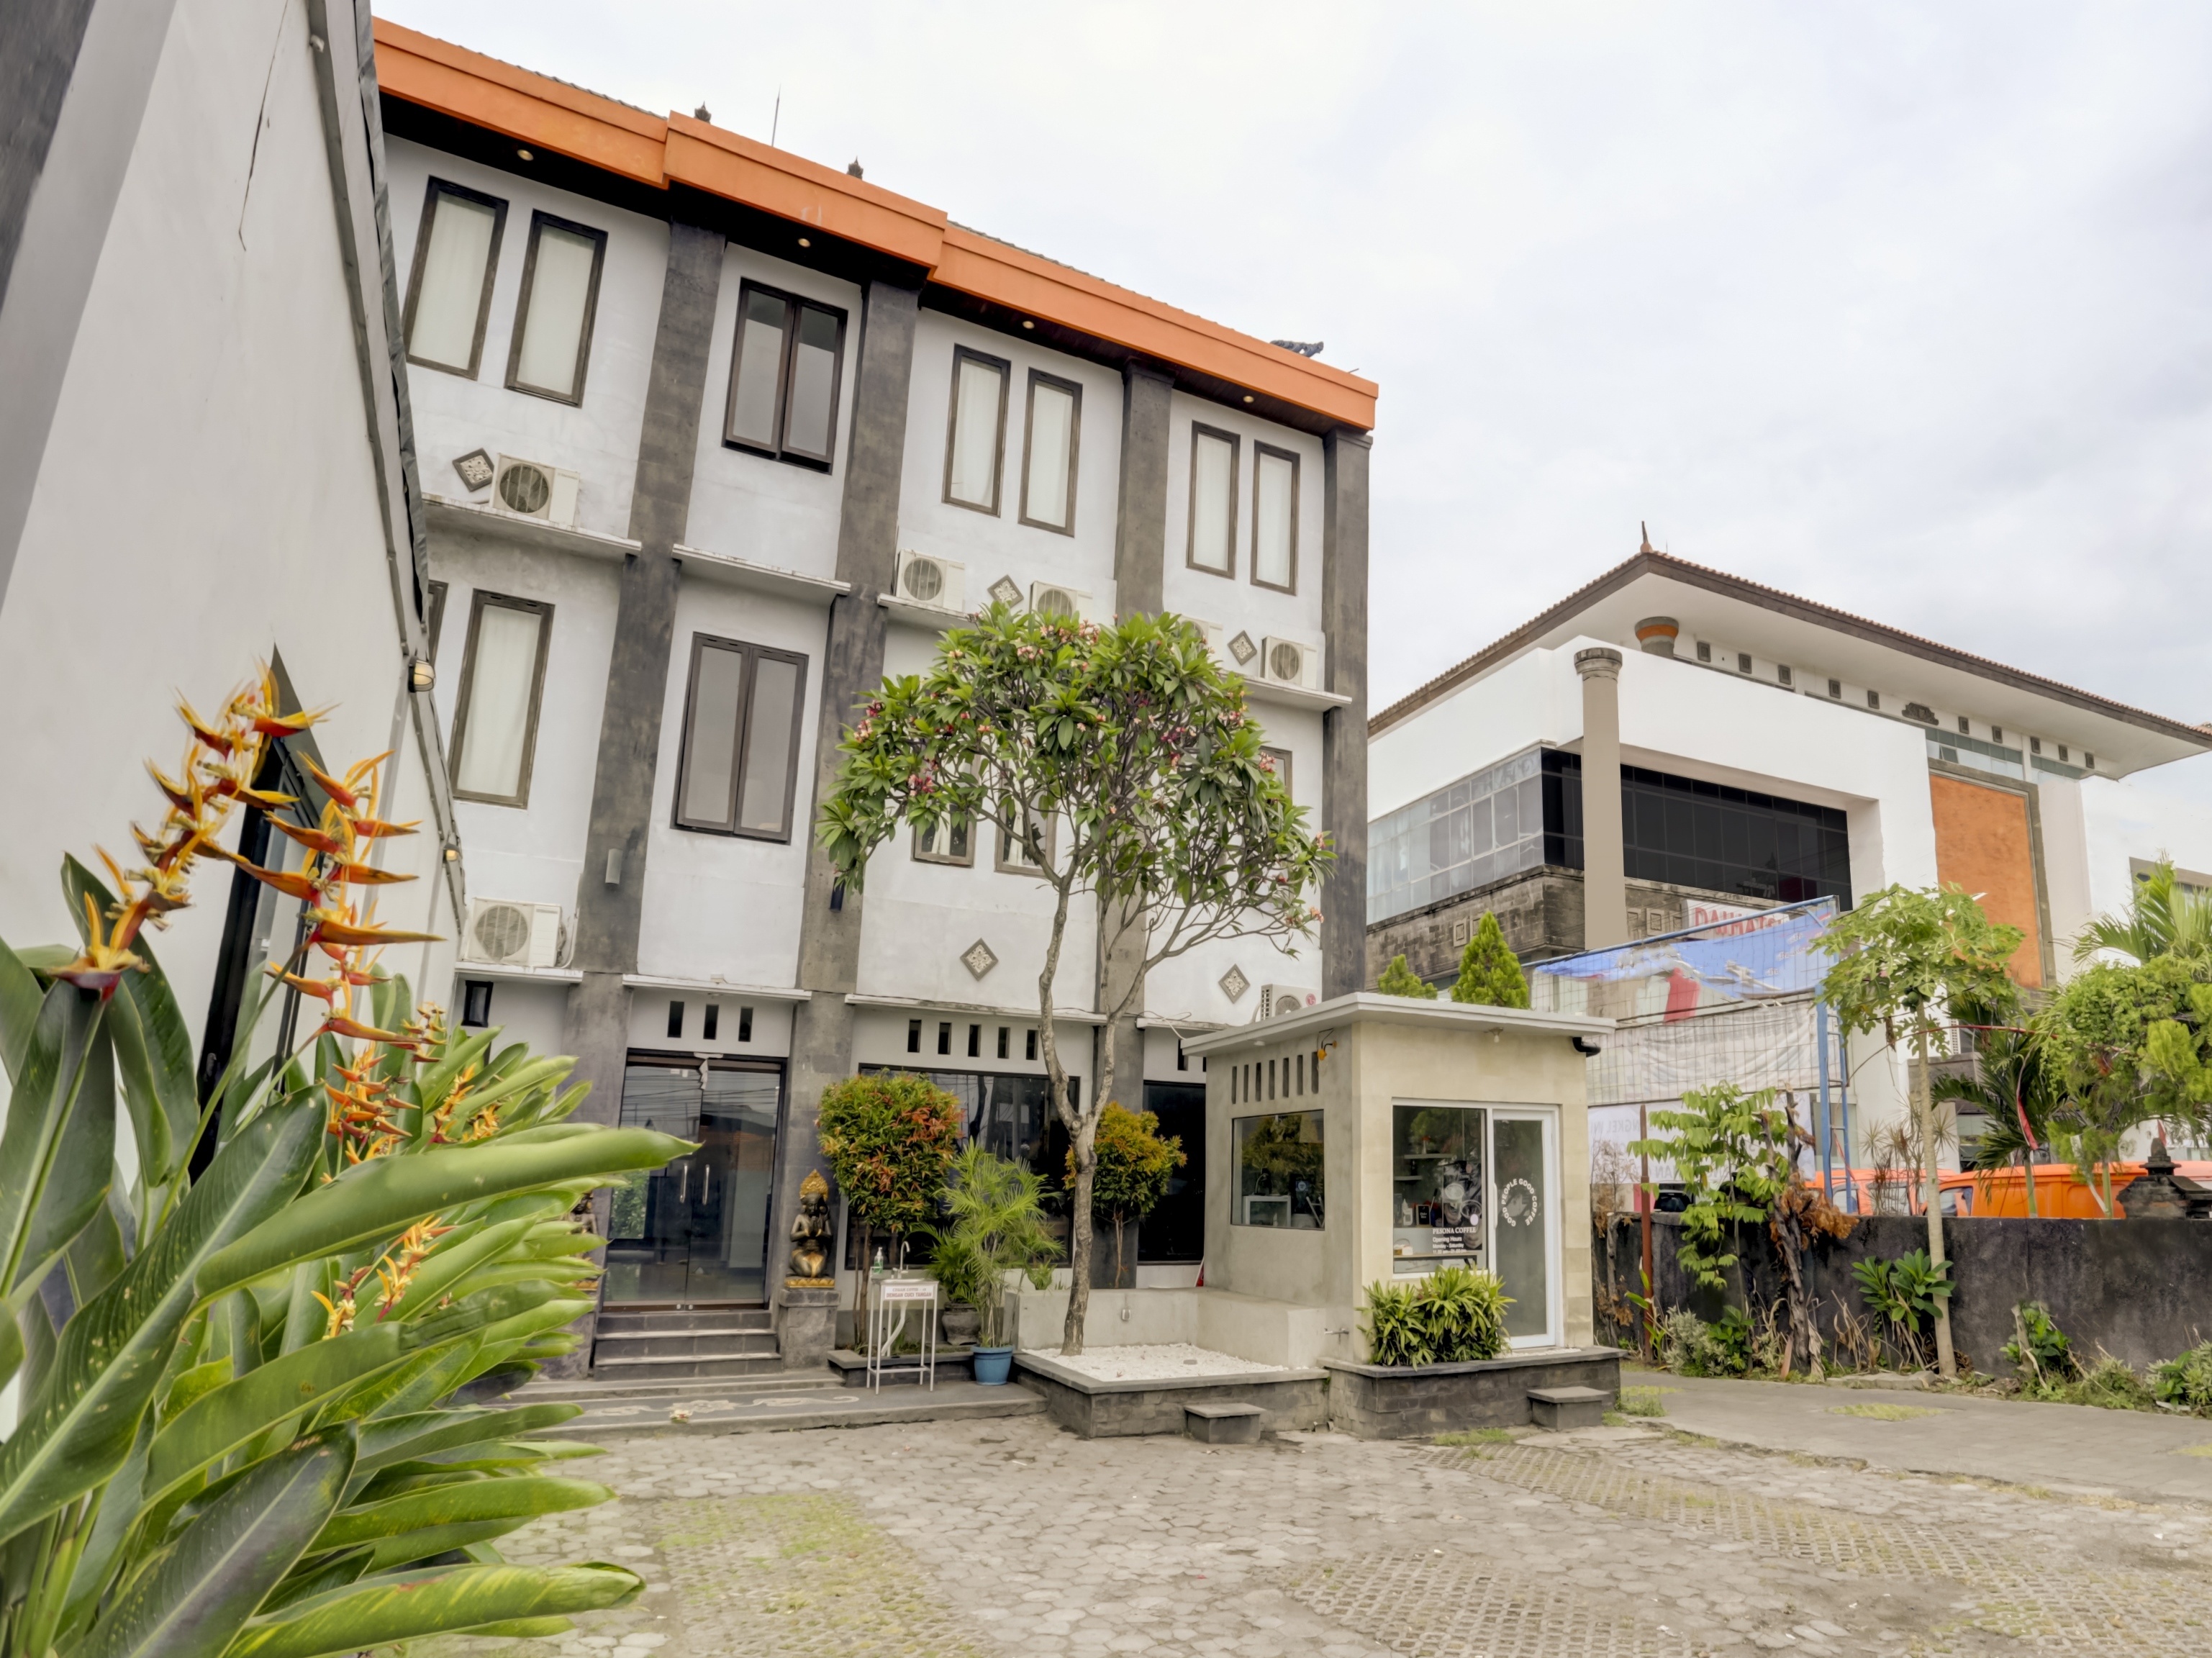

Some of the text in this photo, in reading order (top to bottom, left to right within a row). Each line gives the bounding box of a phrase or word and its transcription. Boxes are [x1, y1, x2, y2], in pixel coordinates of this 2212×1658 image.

[1501, 1178, 1538, 1227] GOOD PEOPLE GOOD COFFEE
